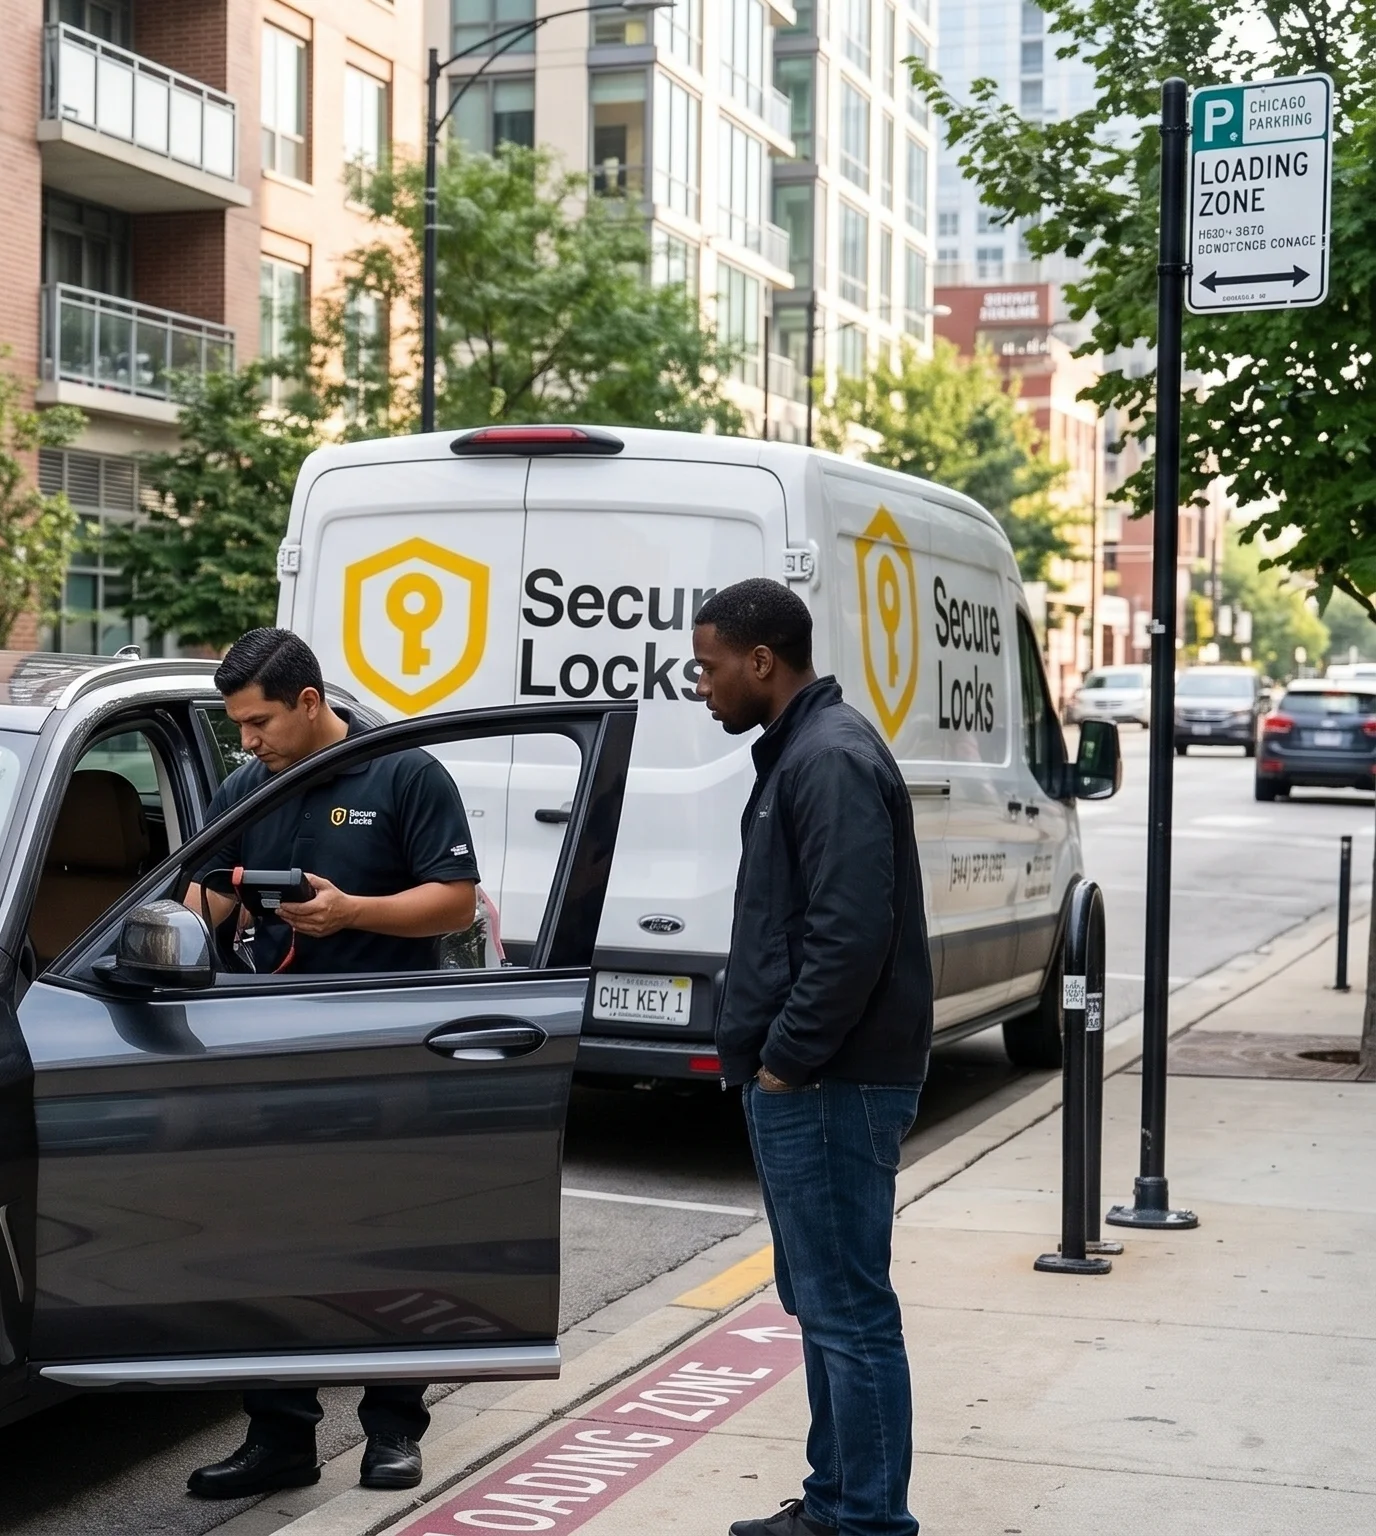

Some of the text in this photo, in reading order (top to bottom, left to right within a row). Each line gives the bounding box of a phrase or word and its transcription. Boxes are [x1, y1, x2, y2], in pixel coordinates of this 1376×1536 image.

[1250, 95, 1306, 113] CHICAGO
[1200, 152, 1308, 185] LOADING
[1199, 187, 1265, 216] ZONE
[522, 568, 717, 631] Secur
[934, 576, 1001, 656] Secure
[938, 660, 994, 734] Locks
[349, 809, 377, 817] Secure
[599, 986, 684, 1013] CHI KEY 1
[421, 1361, 773, 1536] OADING ZONE
